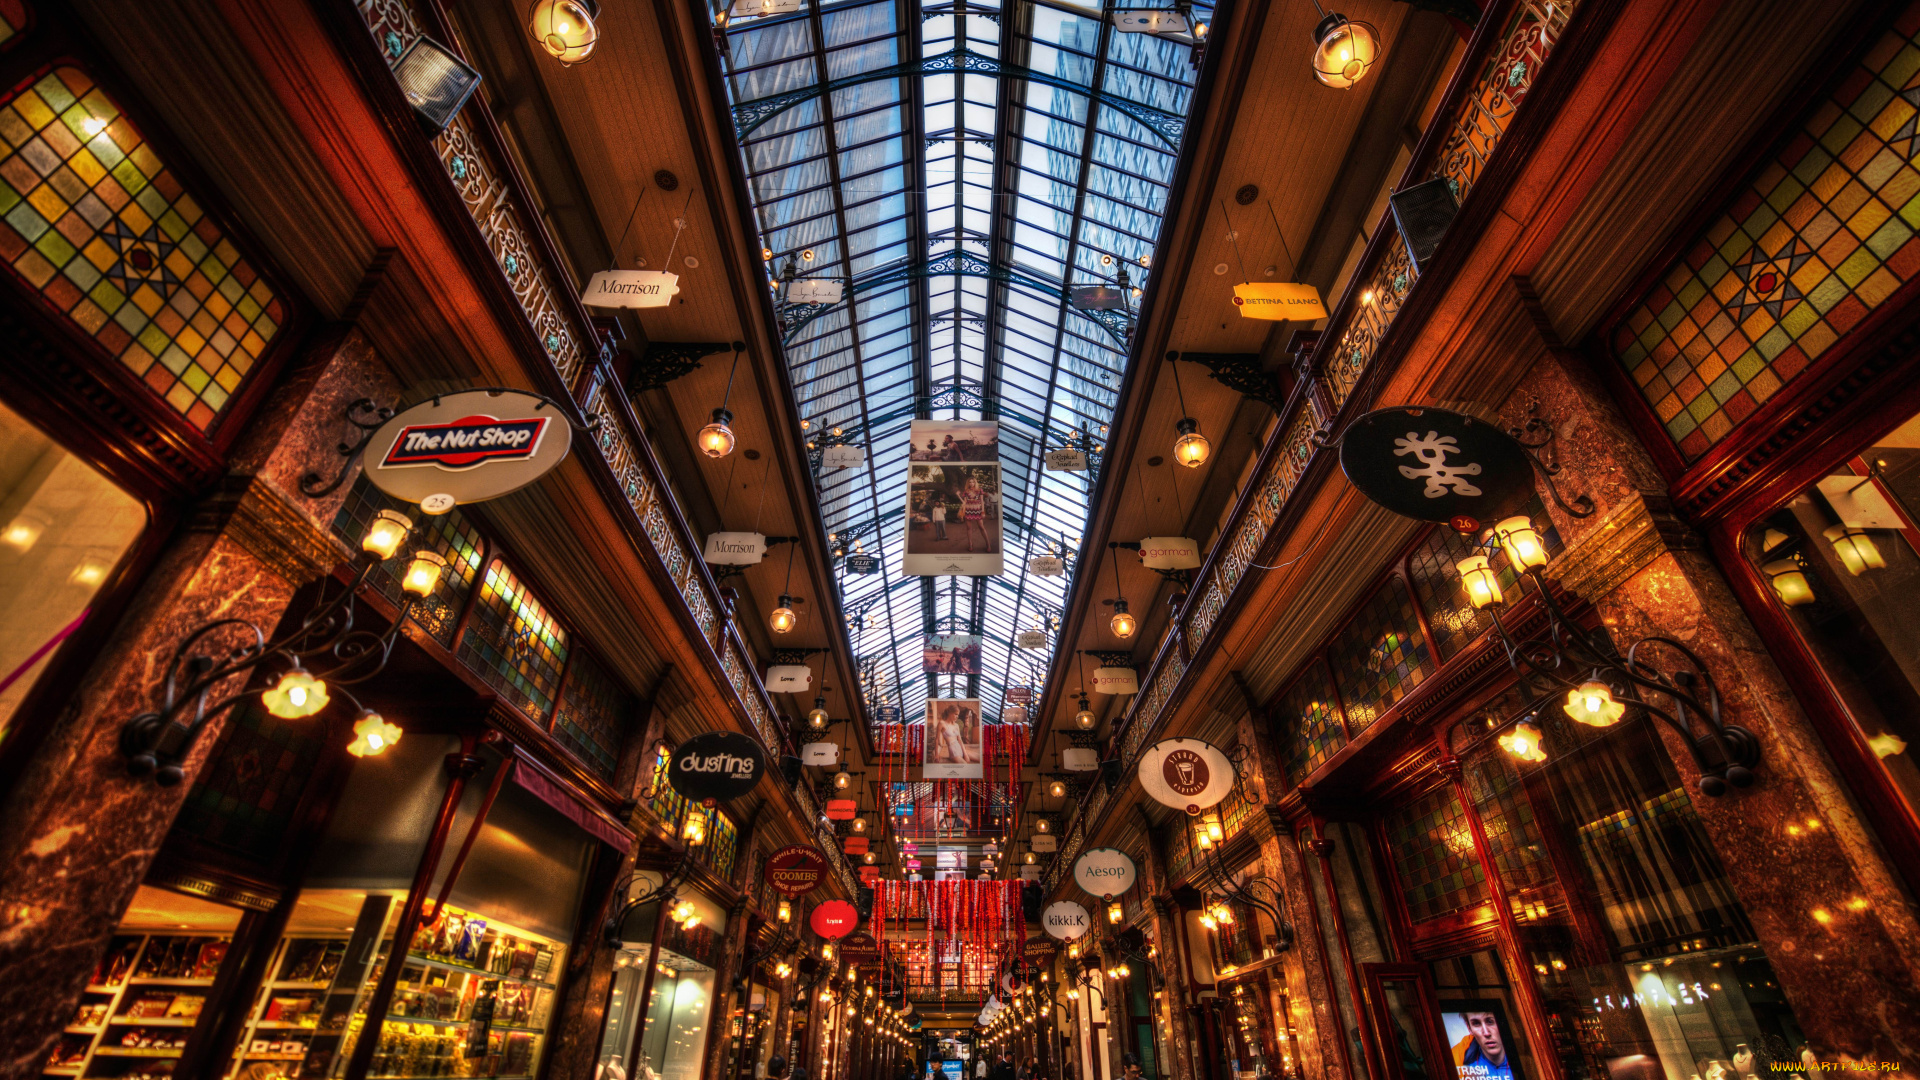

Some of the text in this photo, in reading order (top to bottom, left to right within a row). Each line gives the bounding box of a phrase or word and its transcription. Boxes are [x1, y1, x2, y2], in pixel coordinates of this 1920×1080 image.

[597, 280, 660, 295] Morrison
[405, 427, 531, 451] The Nut Shop
[428, 497, 445, 508] 25
[1456, 518, 1472, 529] 26
[713, 540, 755, 554] Morrison
[1149, 548, 1194, 558] gorman
[1100, 677, 1134, 685] gorman
[680, 752, 754, 774] dustins
[772, 871, 818, 881] COOMBS
[774, 880, 790, 891] SHOE
[1048, 914, 1085, 926] kikki.K
[1026, 942, 1052, 950] GALLERY
[1024, 948, 1055, 956] SHOPPING
[1456, 1065, 1489, 1076] TRASH
